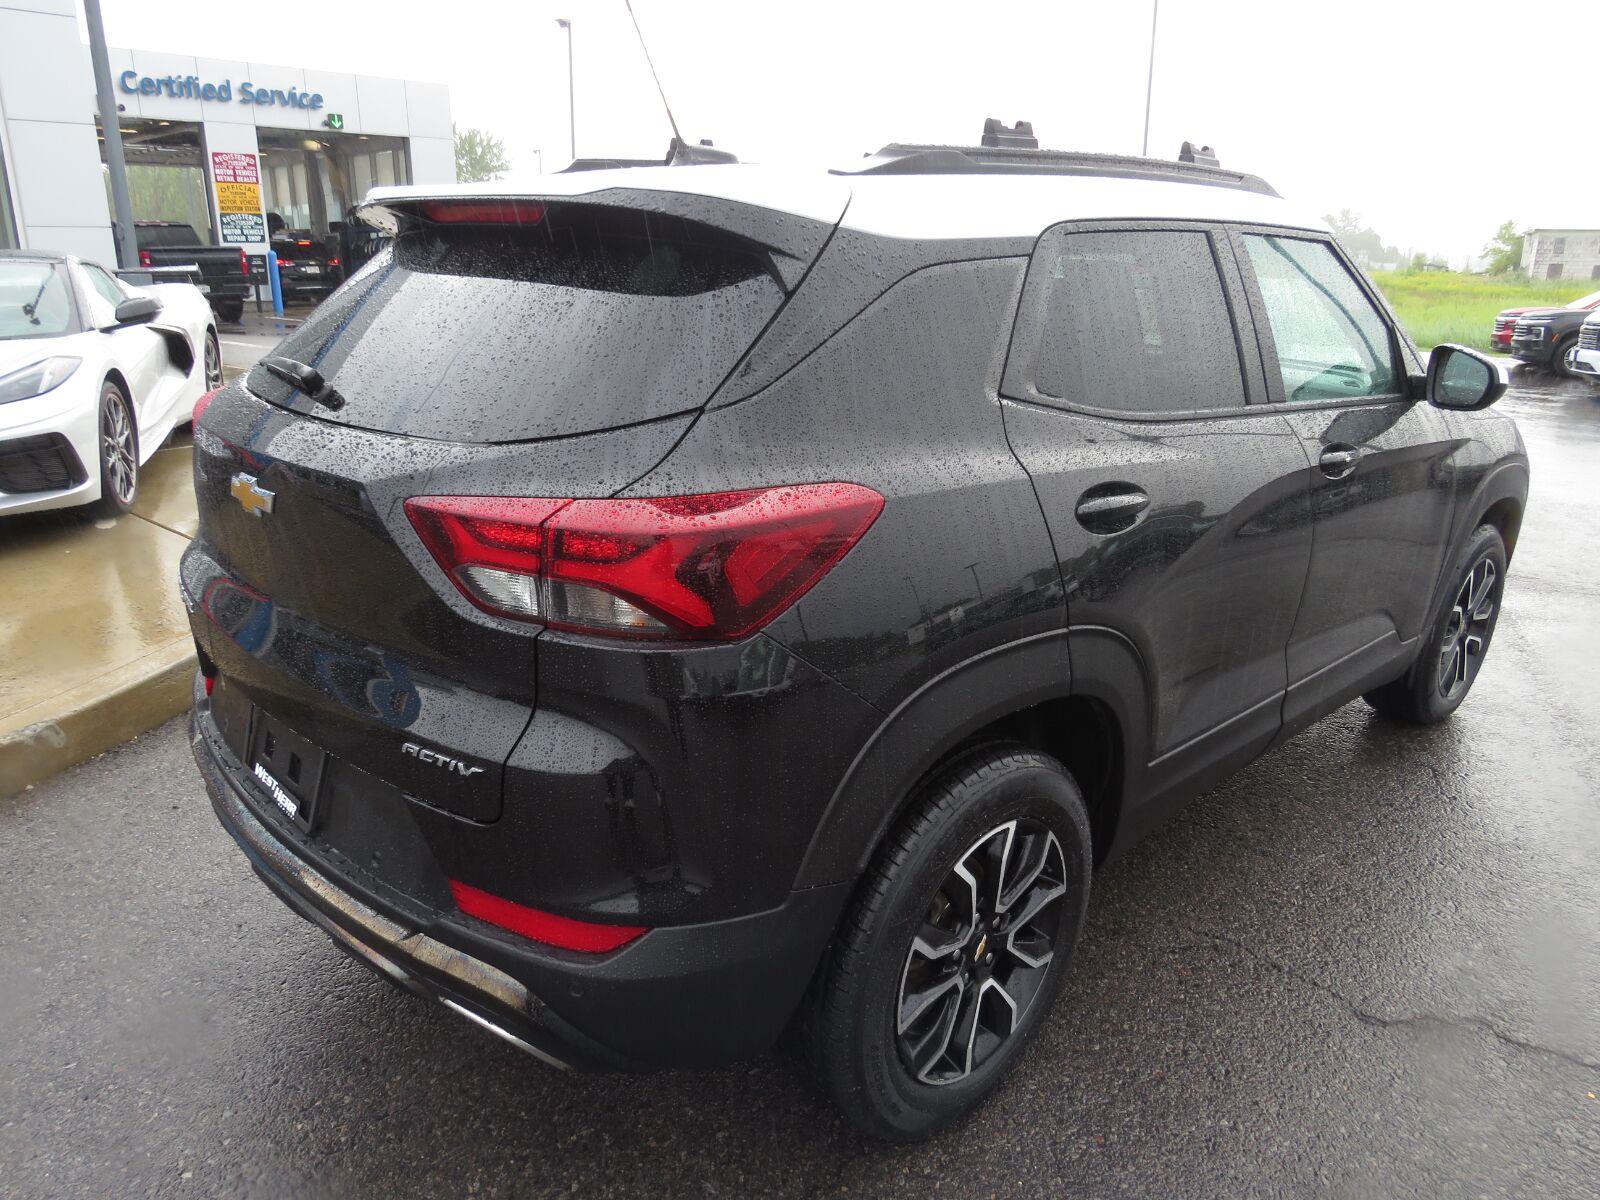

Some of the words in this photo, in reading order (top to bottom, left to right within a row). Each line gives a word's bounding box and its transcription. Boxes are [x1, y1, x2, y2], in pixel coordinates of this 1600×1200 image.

[119, 69, 232, 101] Certified
[239, 81, 324, 110] Service
[214, 153, 255, 164] REGISTERED
[220, 184, 257, 195] OFFICIAL
[222, 213, 262, 224] REGISTERED
[401, 742, 484, 776] ACTIV
[254, 762, 278, 790] WEST
